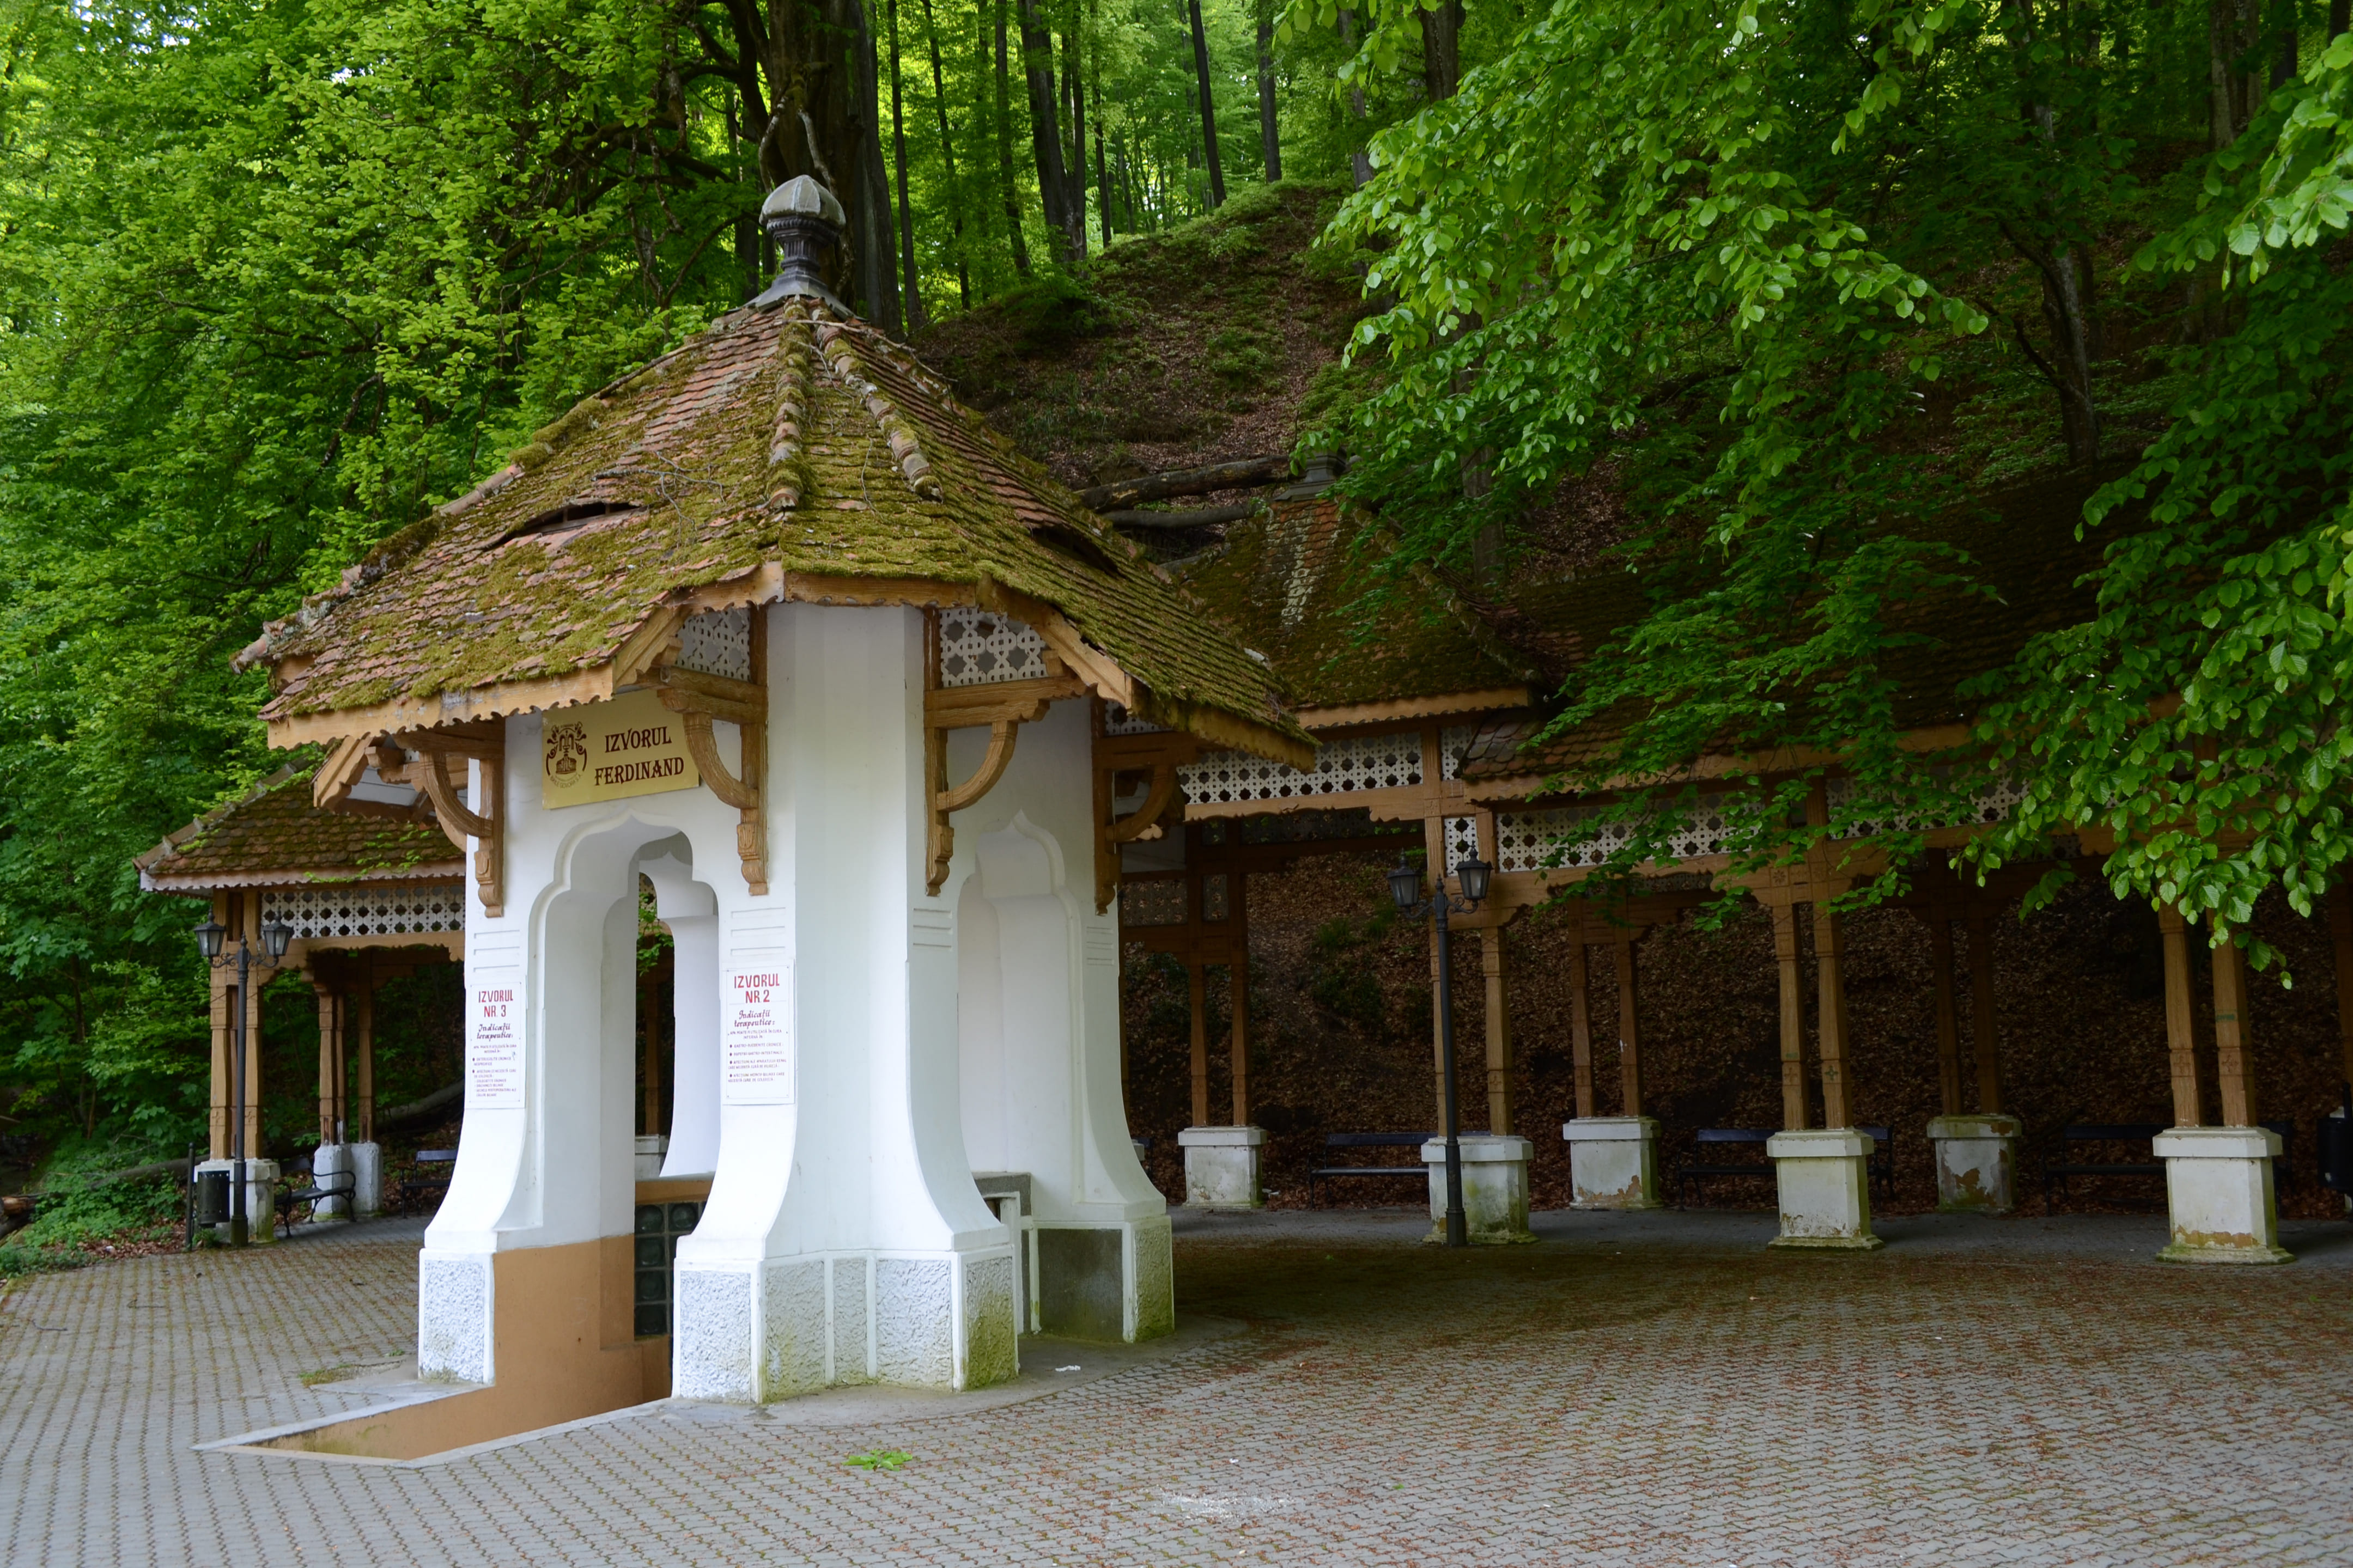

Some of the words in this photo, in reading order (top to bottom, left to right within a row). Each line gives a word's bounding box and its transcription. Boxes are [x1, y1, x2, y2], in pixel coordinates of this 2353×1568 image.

[605, 726, 672, 753] IZVORUL
[594, 757, 684, 786] FERDINAND
[734, 973, 780, 989] IZVORUL
[478, 990, 513, 1003] IZVORUL
[763, 990, 770, 1003] 2
[501, 1005, 506, 1017] 3
